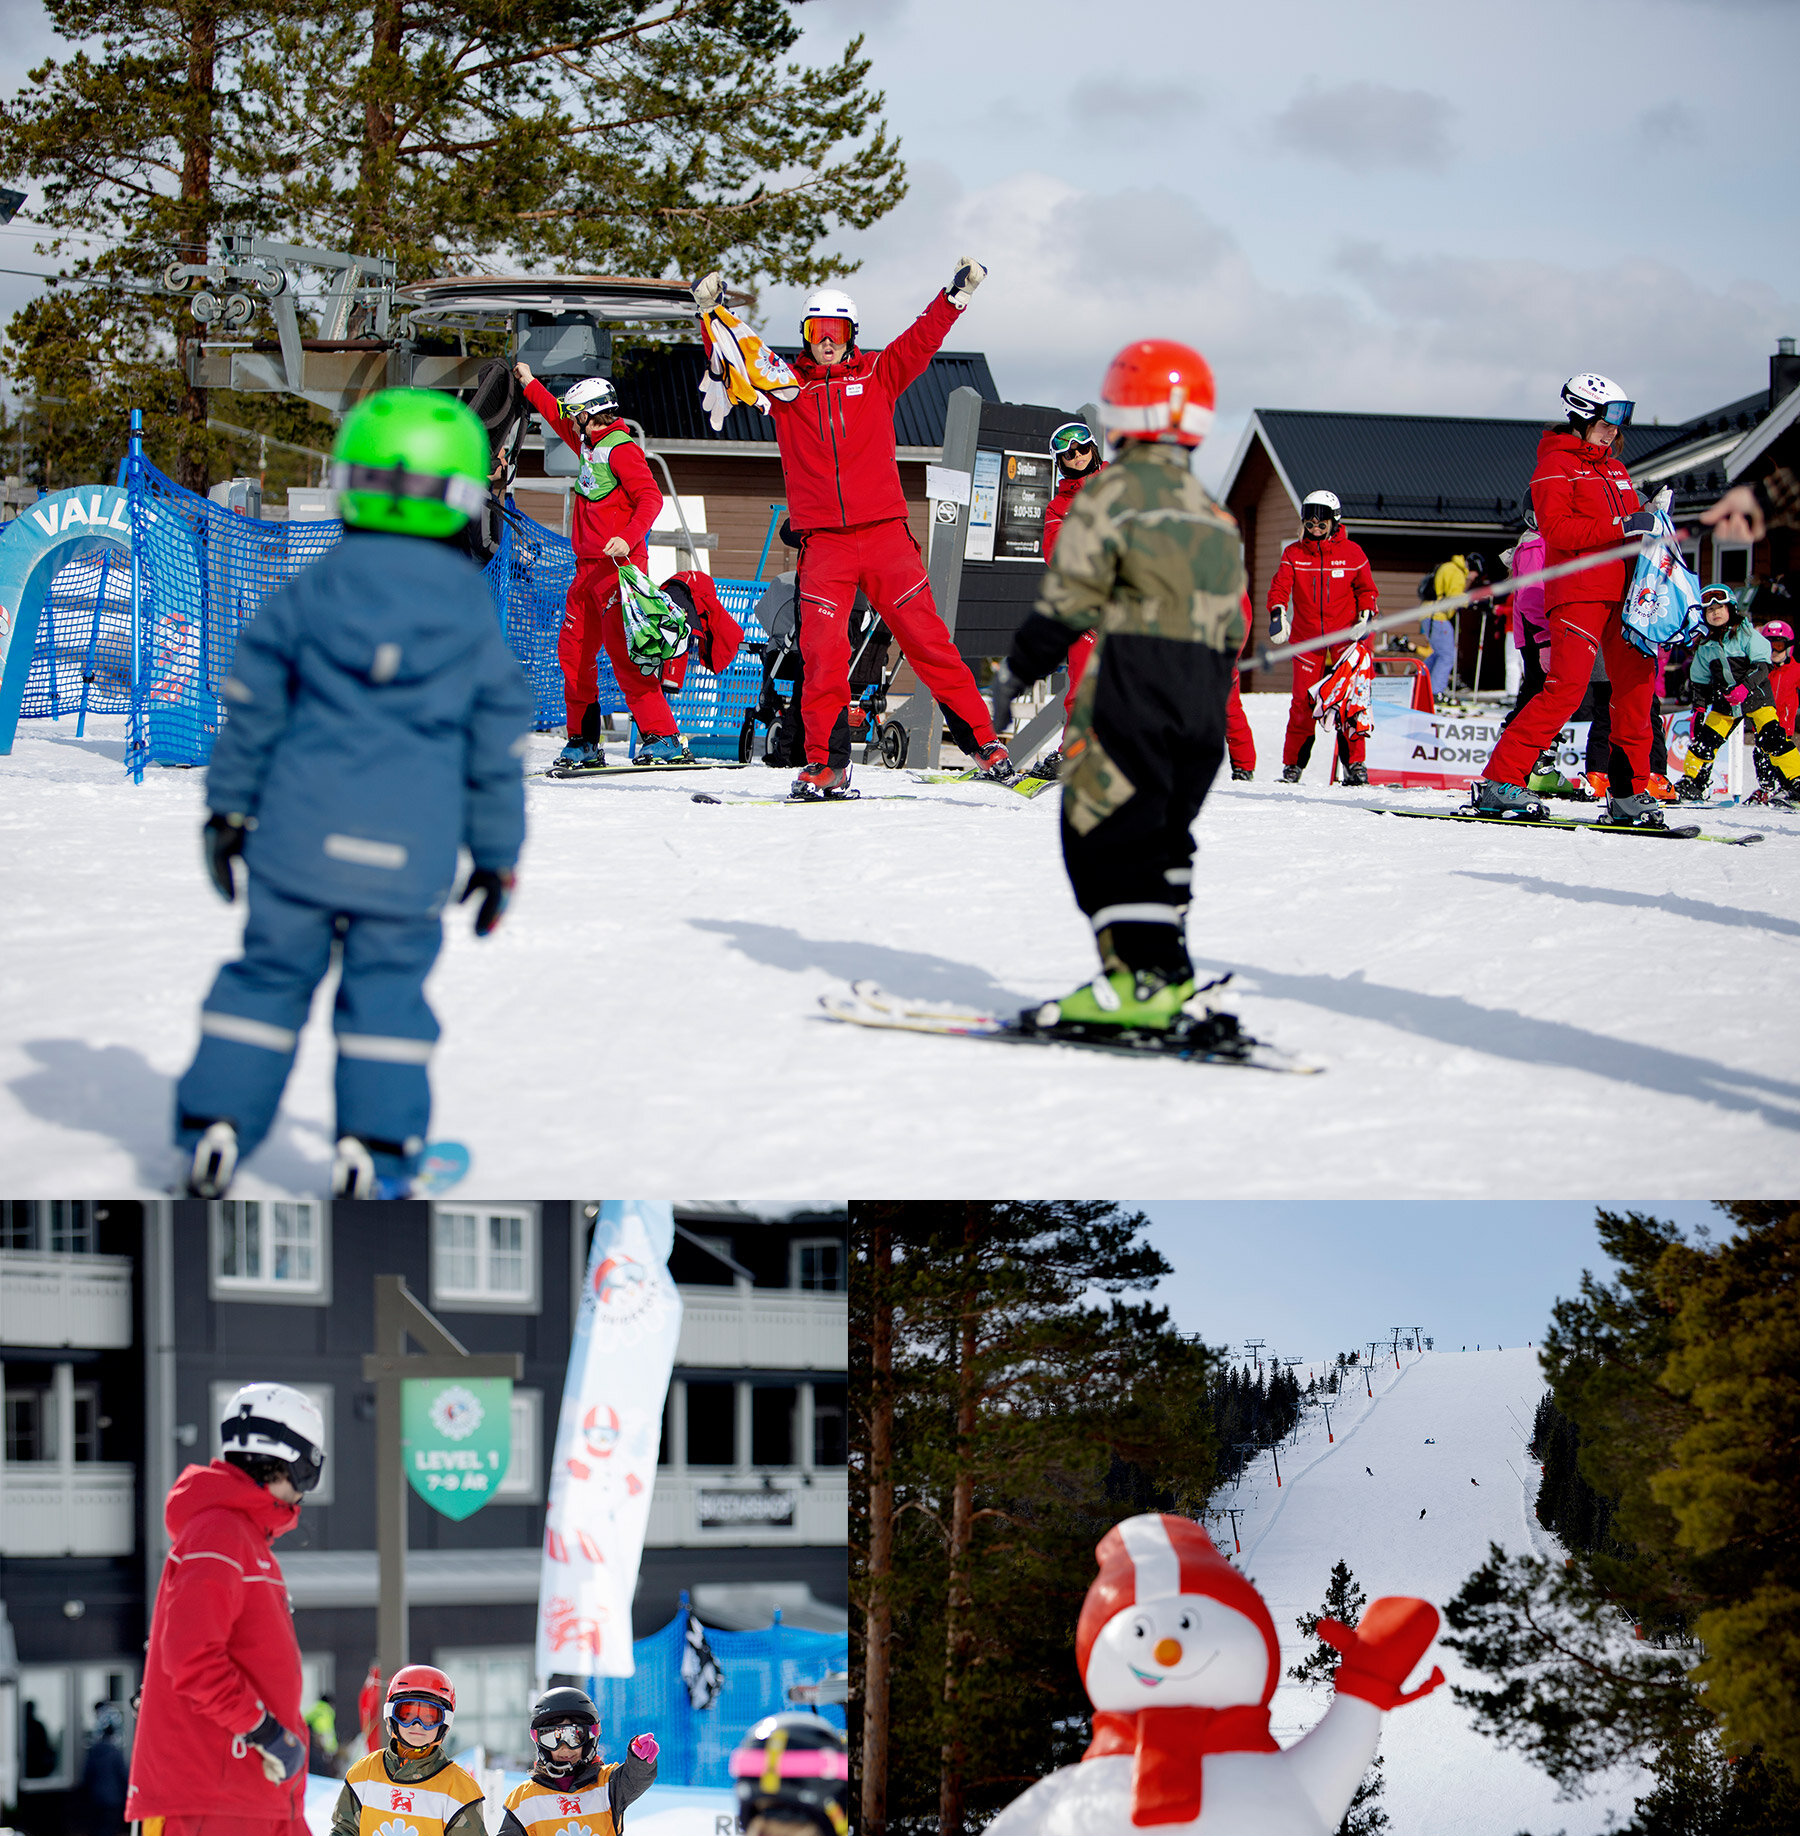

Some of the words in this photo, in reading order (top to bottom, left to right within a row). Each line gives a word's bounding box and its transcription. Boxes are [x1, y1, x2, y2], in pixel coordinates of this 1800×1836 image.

[1016, 461, 1037, 477] Svalan
[818, 608, 834, 618] EQPE
[415, 1450, 483, 1471] LEVEL
[487, 1450, 499, 1470] 1
